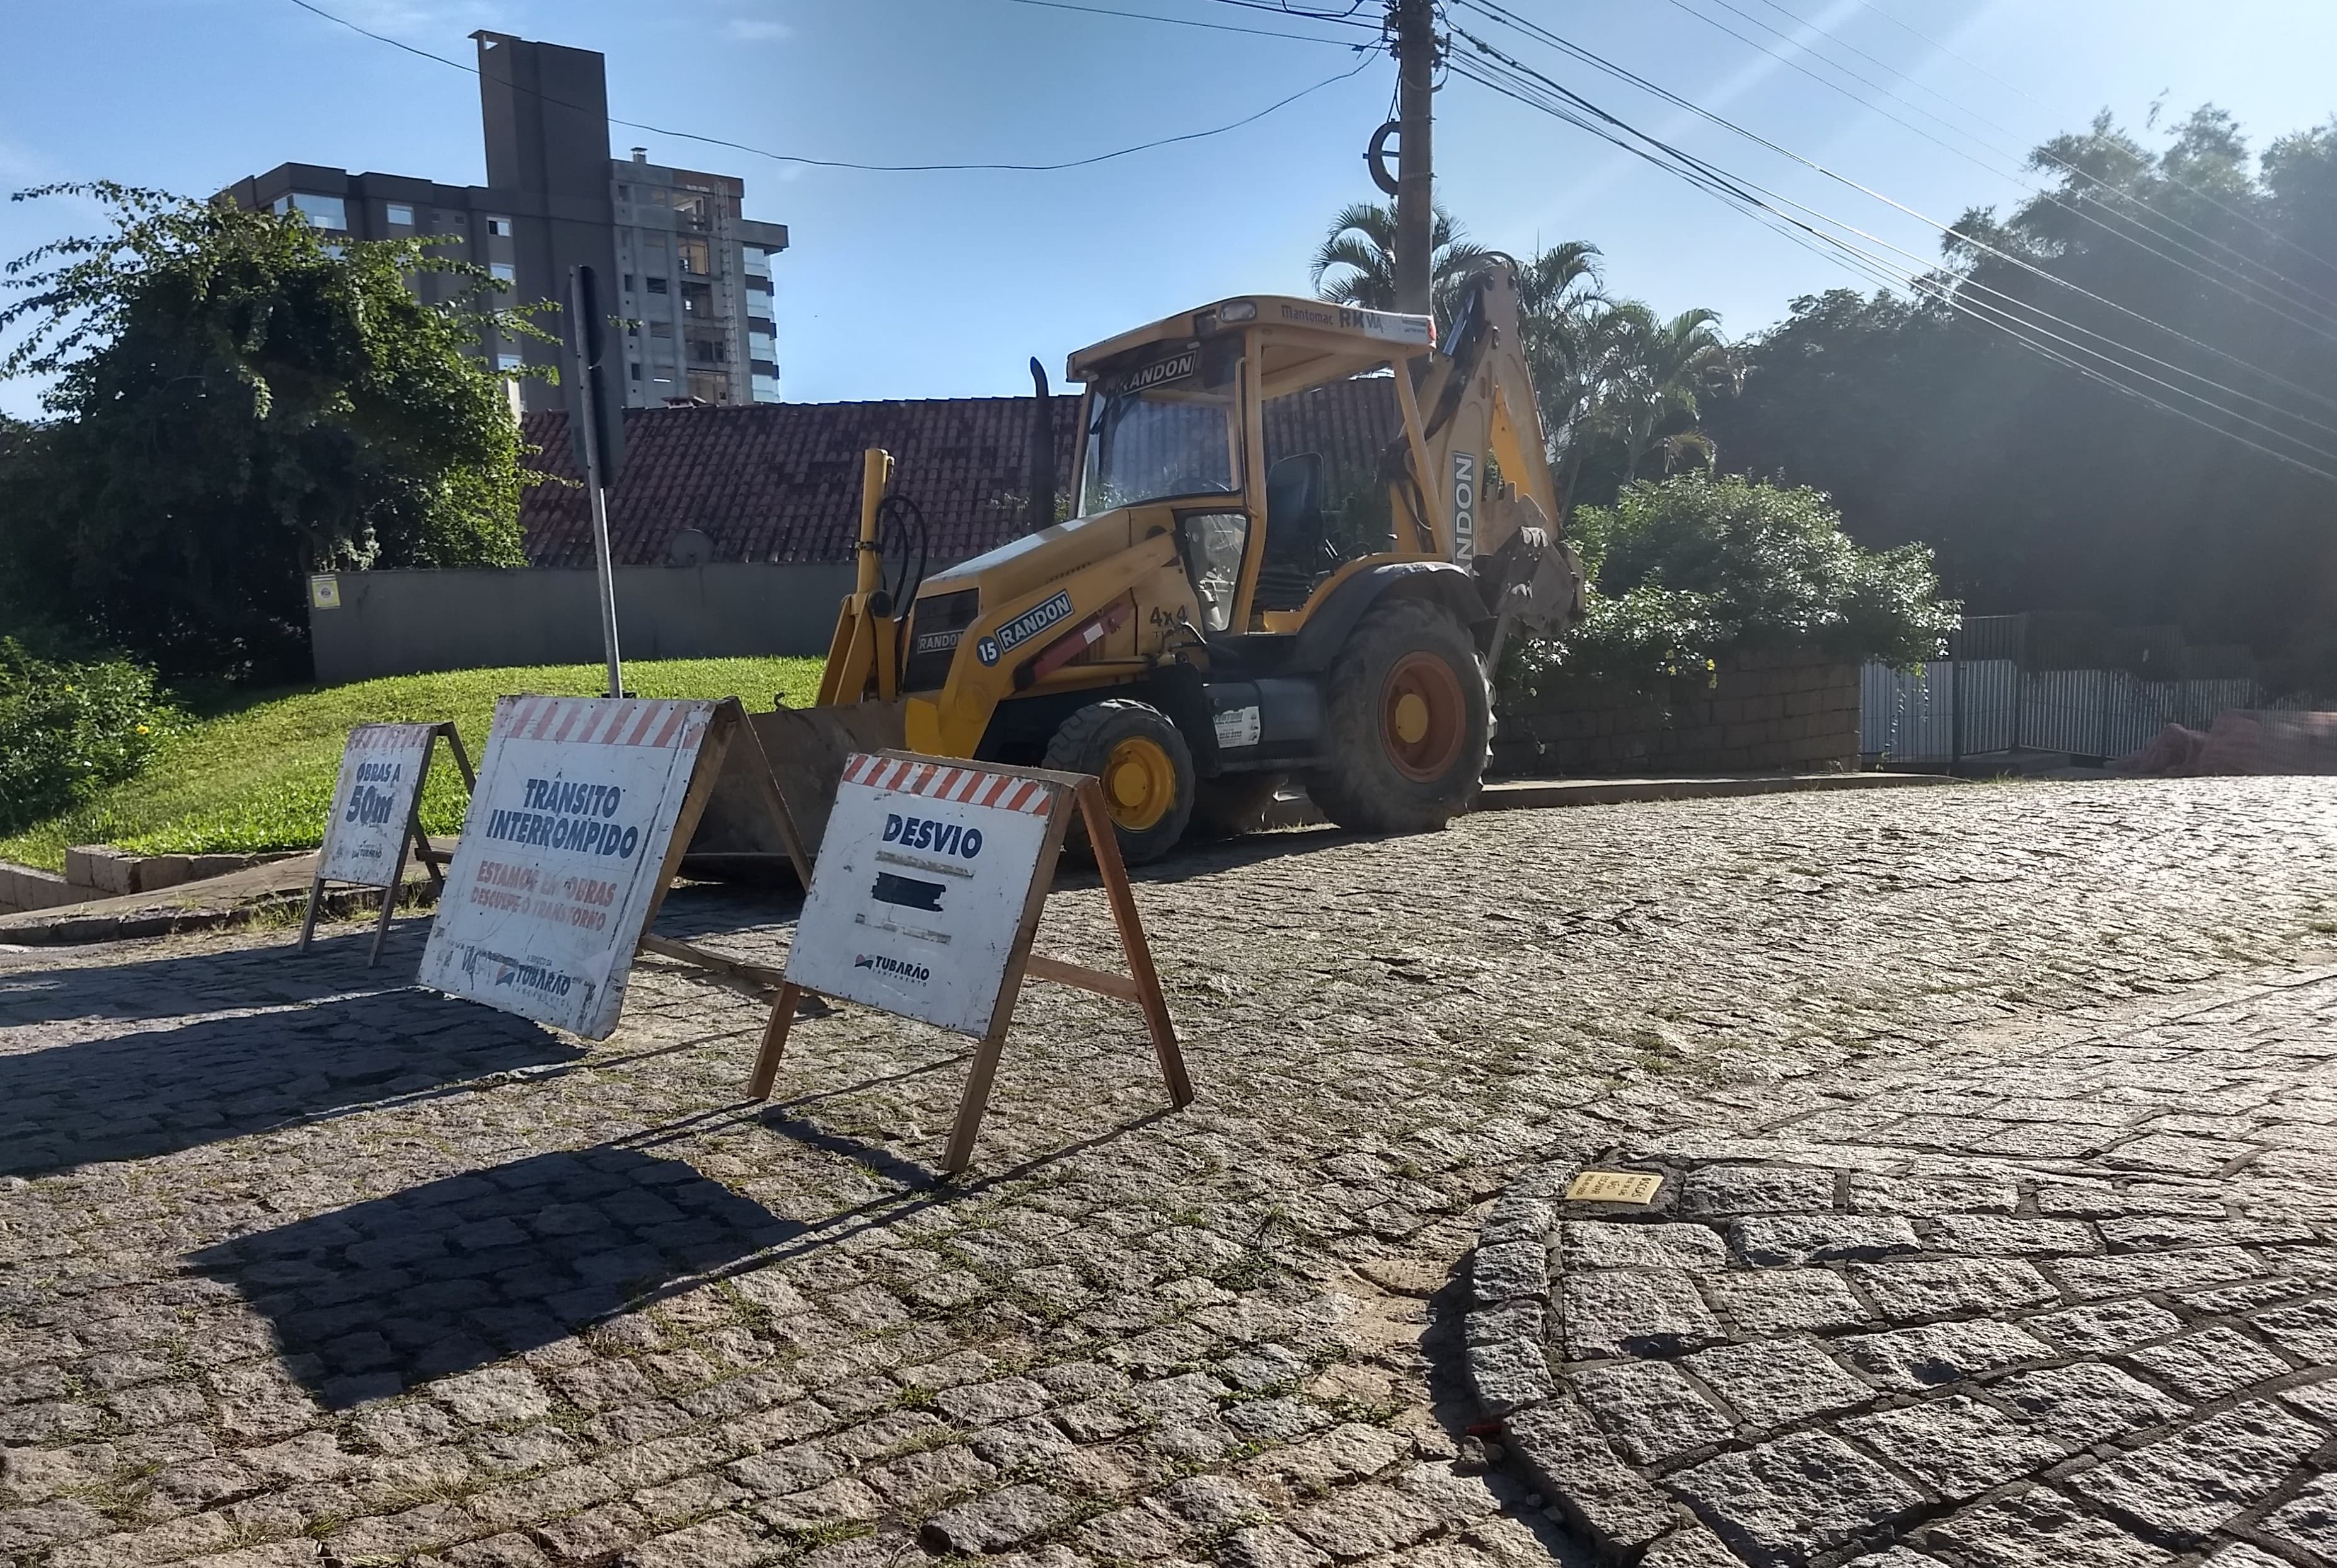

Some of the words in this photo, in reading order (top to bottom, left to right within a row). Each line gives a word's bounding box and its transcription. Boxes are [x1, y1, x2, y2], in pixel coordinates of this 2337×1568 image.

[1456, 458, 1472, 570] NDON
[1001, 596, 1070, 647] RANDON
[979, 642, 997, 662] 15
[356, 763, 392, 783] OBRAS
[392, 763, 401, 782] A
[524, 771, 621, 818] TRÂNSITO
[345, 785, 394, 824] 50m
[486, 809, 638, 859] INTERROMPIDO
[882, 813, 983, 859] DESVIO
[476, 860, 541, 892] ESTAMOS
[565, 876, 618, 908] OBRAS
[875, 955, 930, 981] TUBARÃO
